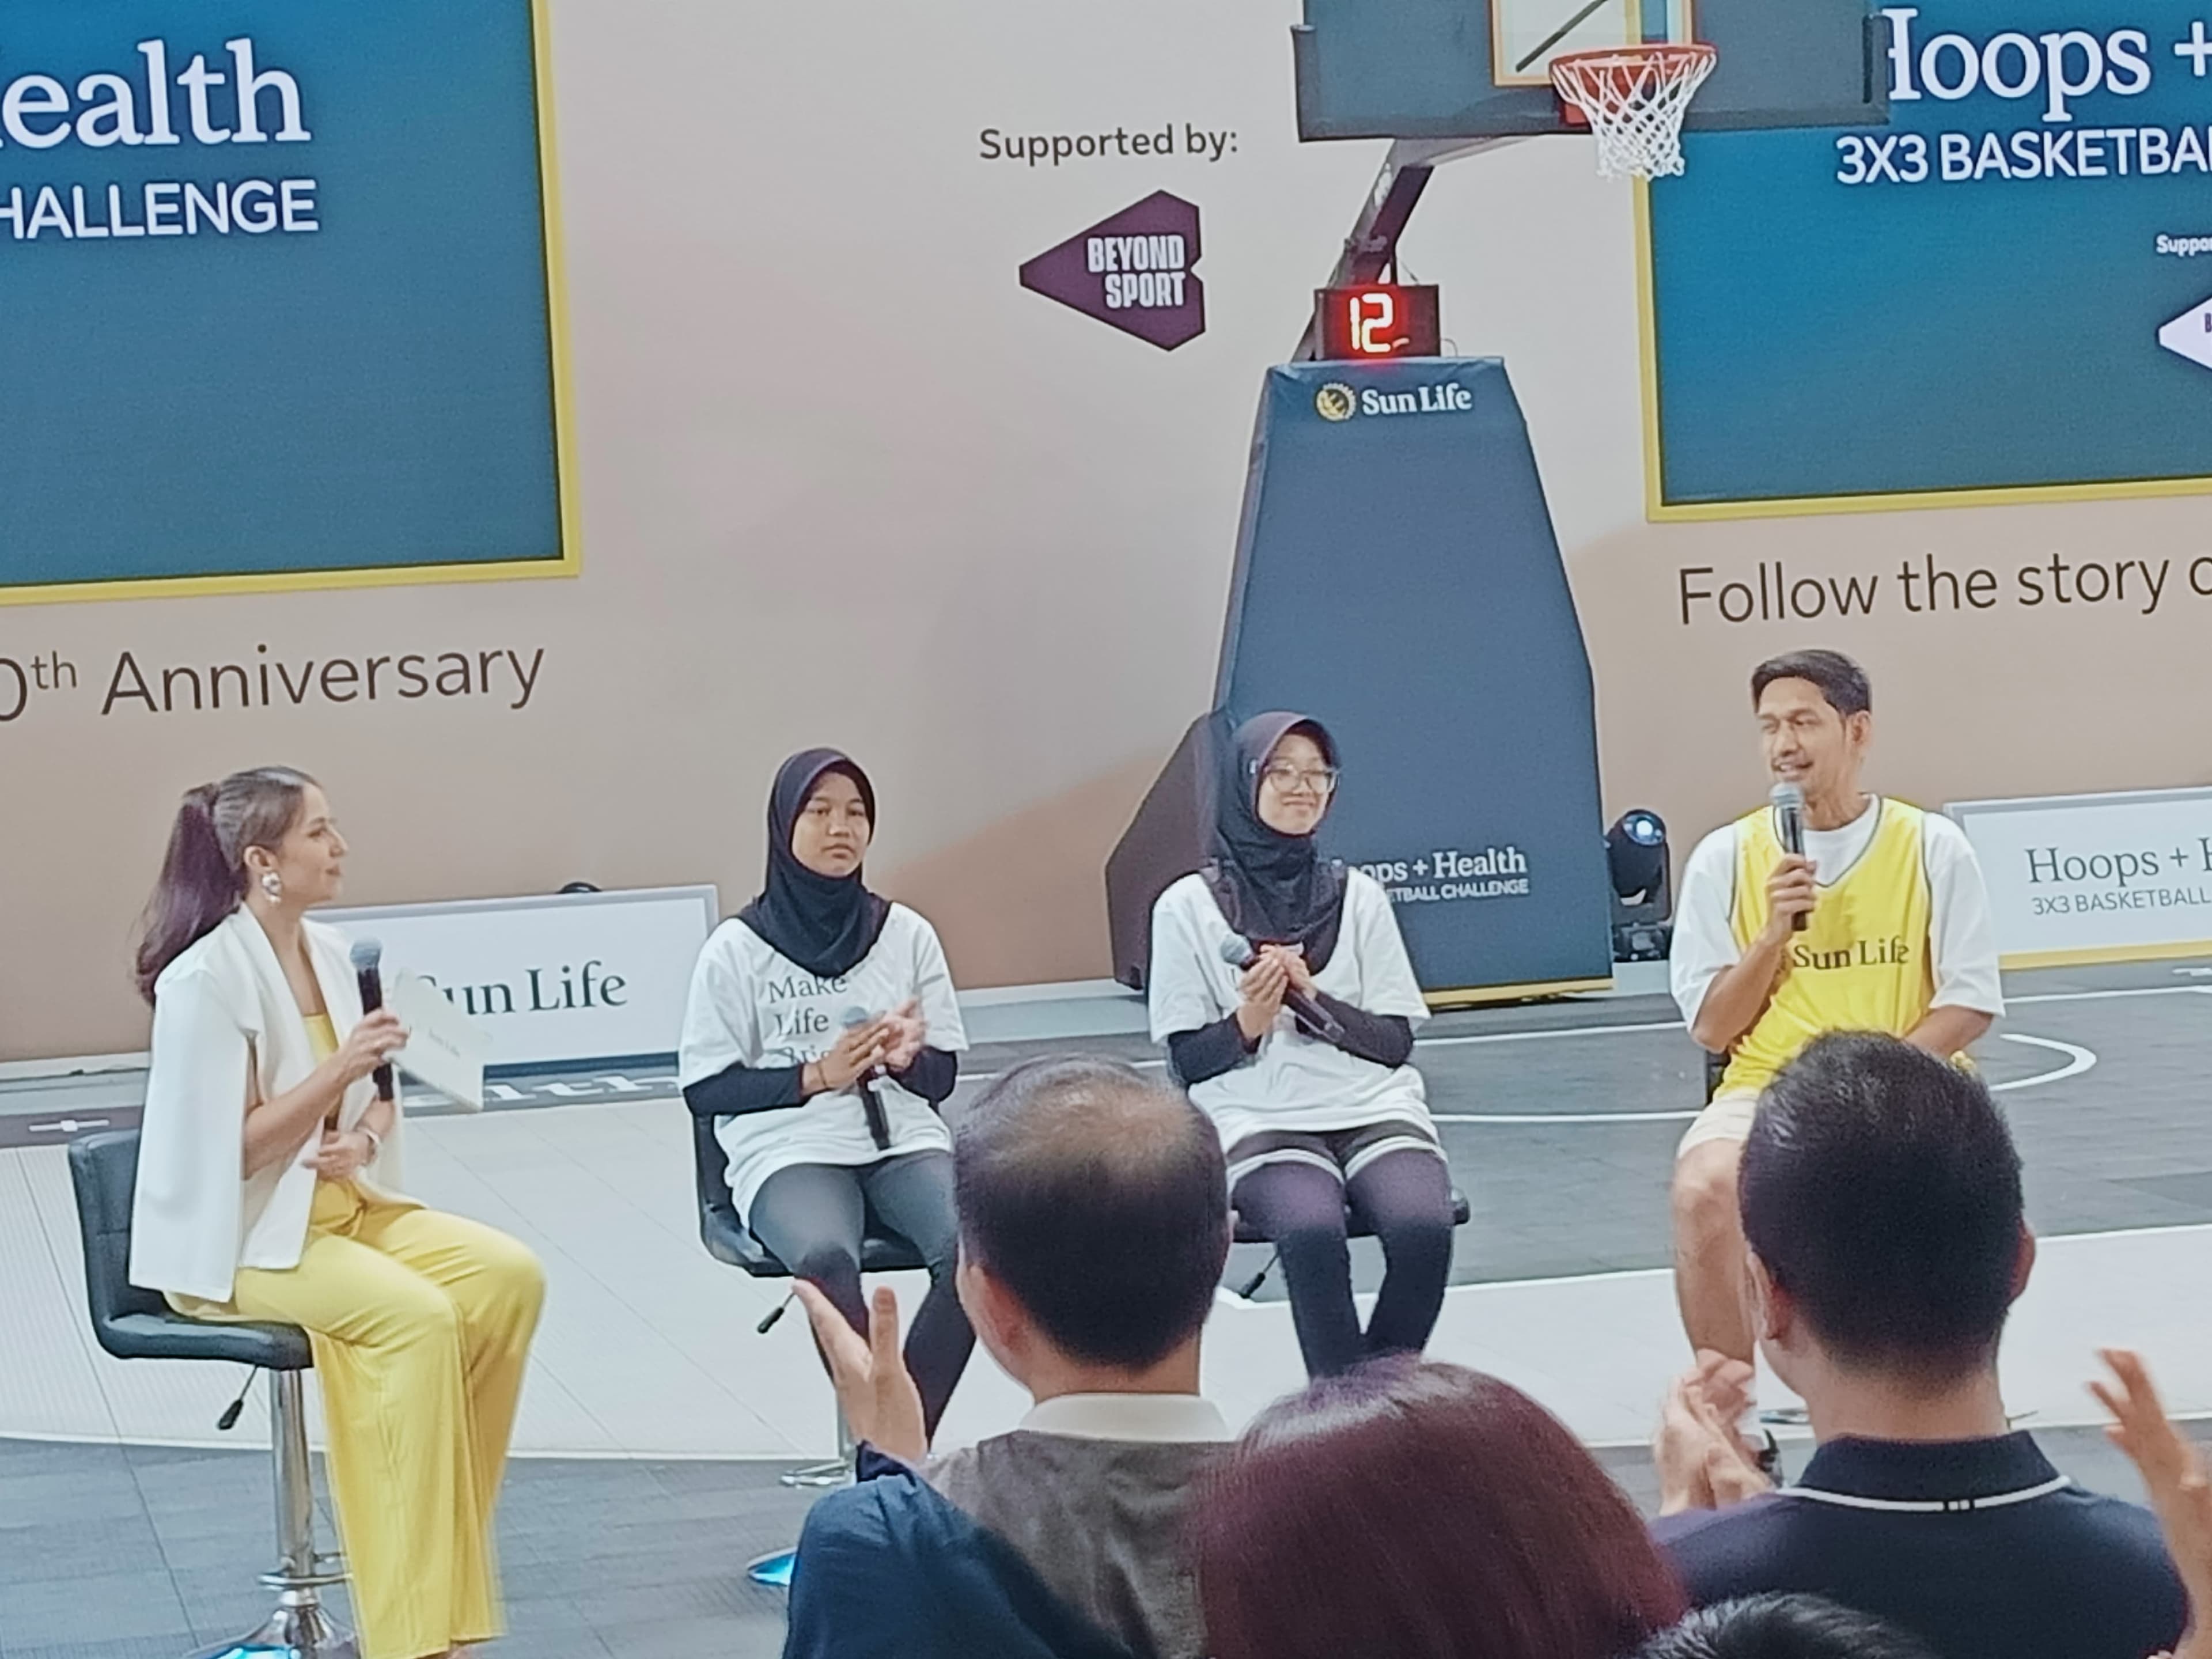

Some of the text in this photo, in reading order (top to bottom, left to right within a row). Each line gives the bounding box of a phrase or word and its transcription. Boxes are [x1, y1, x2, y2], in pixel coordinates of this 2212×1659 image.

[0, 38, 311, 149] ealth
[980, 123, 1237, 166] Supported by:
[1836, 126, 2212, 184] 3X3 BASKETBA
[1087, 234, 1185, 272] BEYOND
[2156, 234, 2212, 257] Suppo
[1104, 271, 1185, 308] SPORT
[1350, 293, 1393, 353] 12
[1361, 382, 1472, 415] Sun Life
[1680, 561, 1878, 625] Follow
[1897, 554, 1997, 612] the
[2018, 553, 2169, 615] story
[100, 644, 544, 715] Anniversary
[1432, 846, 1528, 879] Health
[2024, 847, 2160, 887] Hoops
[1441, 878, 1529, 900] CHALLENGE
[2032, 887, 2211, 915] 3X3 BASKETBALL
[1793, 935, 1910, 970] Sun Life
[415, 960, 627, 1016] un Life
[768, 976, 848, 1004] Make
[774, 1007, 829, 1037] Life
